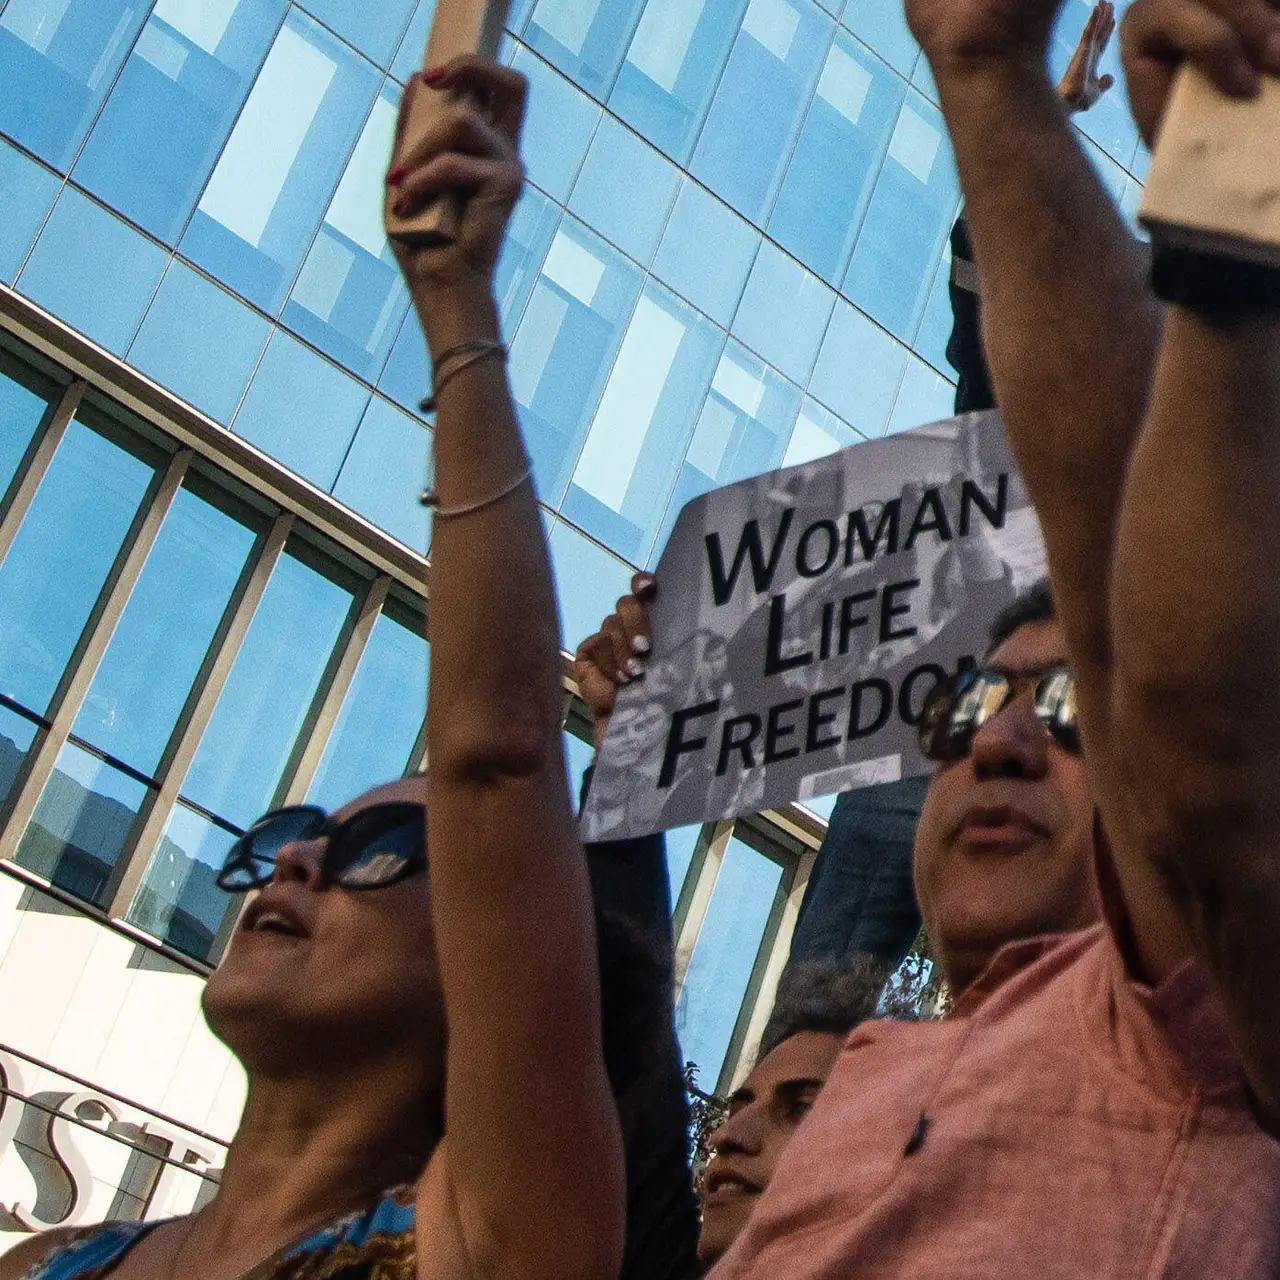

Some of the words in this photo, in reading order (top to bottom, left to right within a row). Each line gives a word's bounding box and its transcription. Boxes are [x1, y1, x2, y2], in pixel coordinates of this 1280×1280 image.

[704, 473, 1009, 608] WOMAN
[764, 577, 921, 678] LIFE
[656, 655, 976, 790] FREEDO
